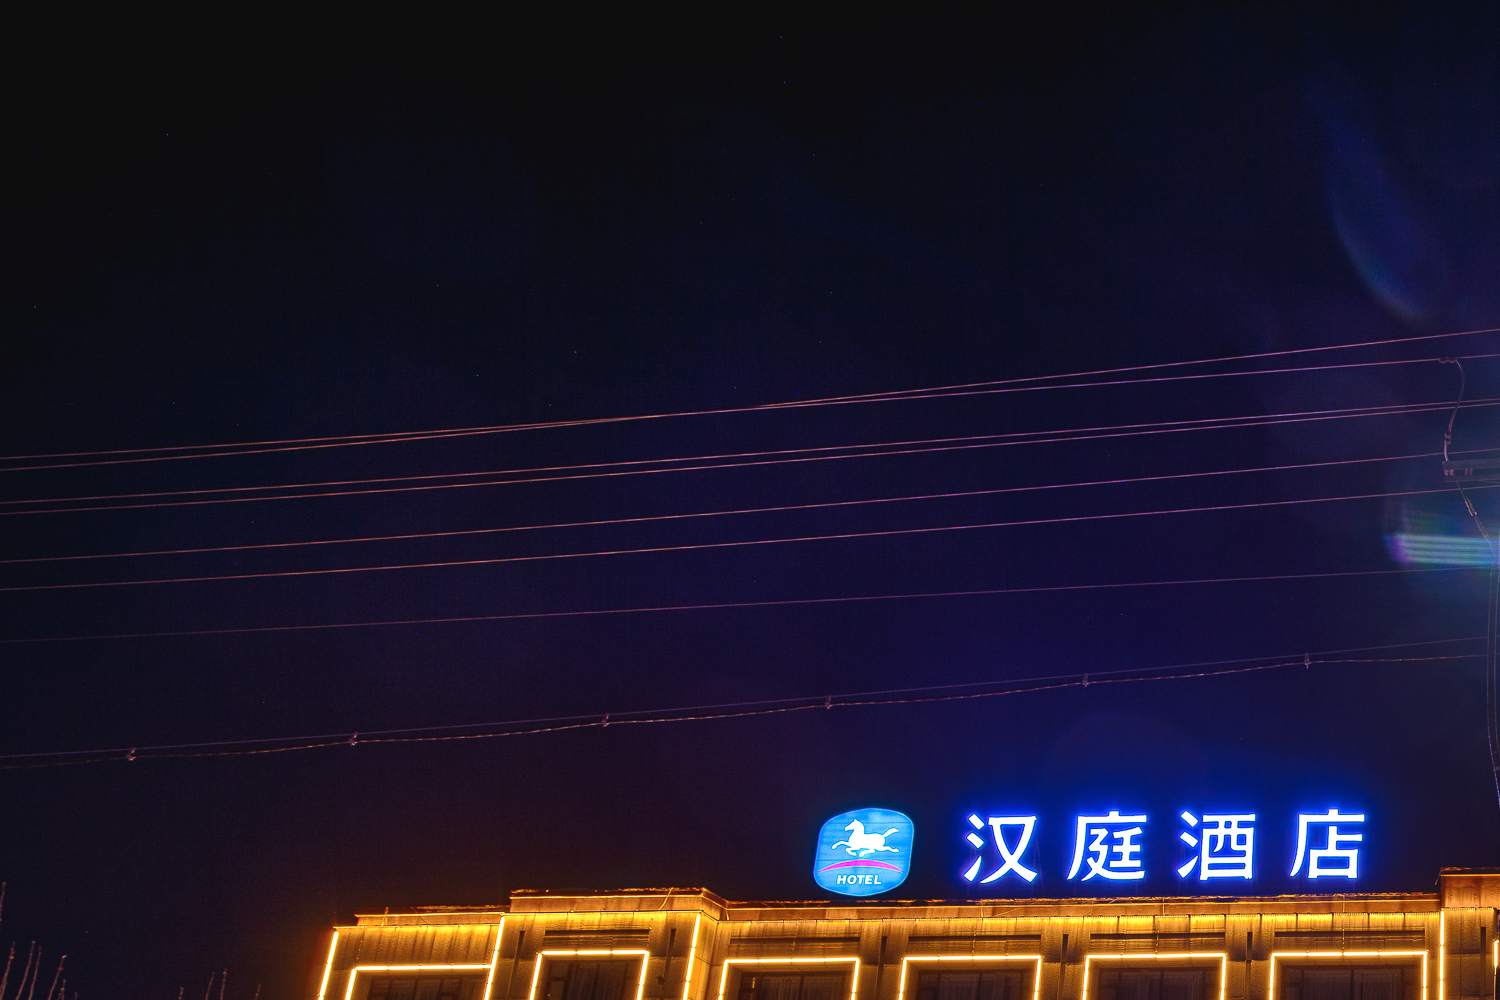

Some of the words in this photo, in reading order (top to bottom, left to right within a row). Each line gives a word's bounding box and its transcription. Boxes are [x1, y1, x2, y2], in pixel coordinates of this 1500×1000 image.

[962, 808, 1367, 884] 汉庭酒店
[836, 874, 882, 886] HOTEL
